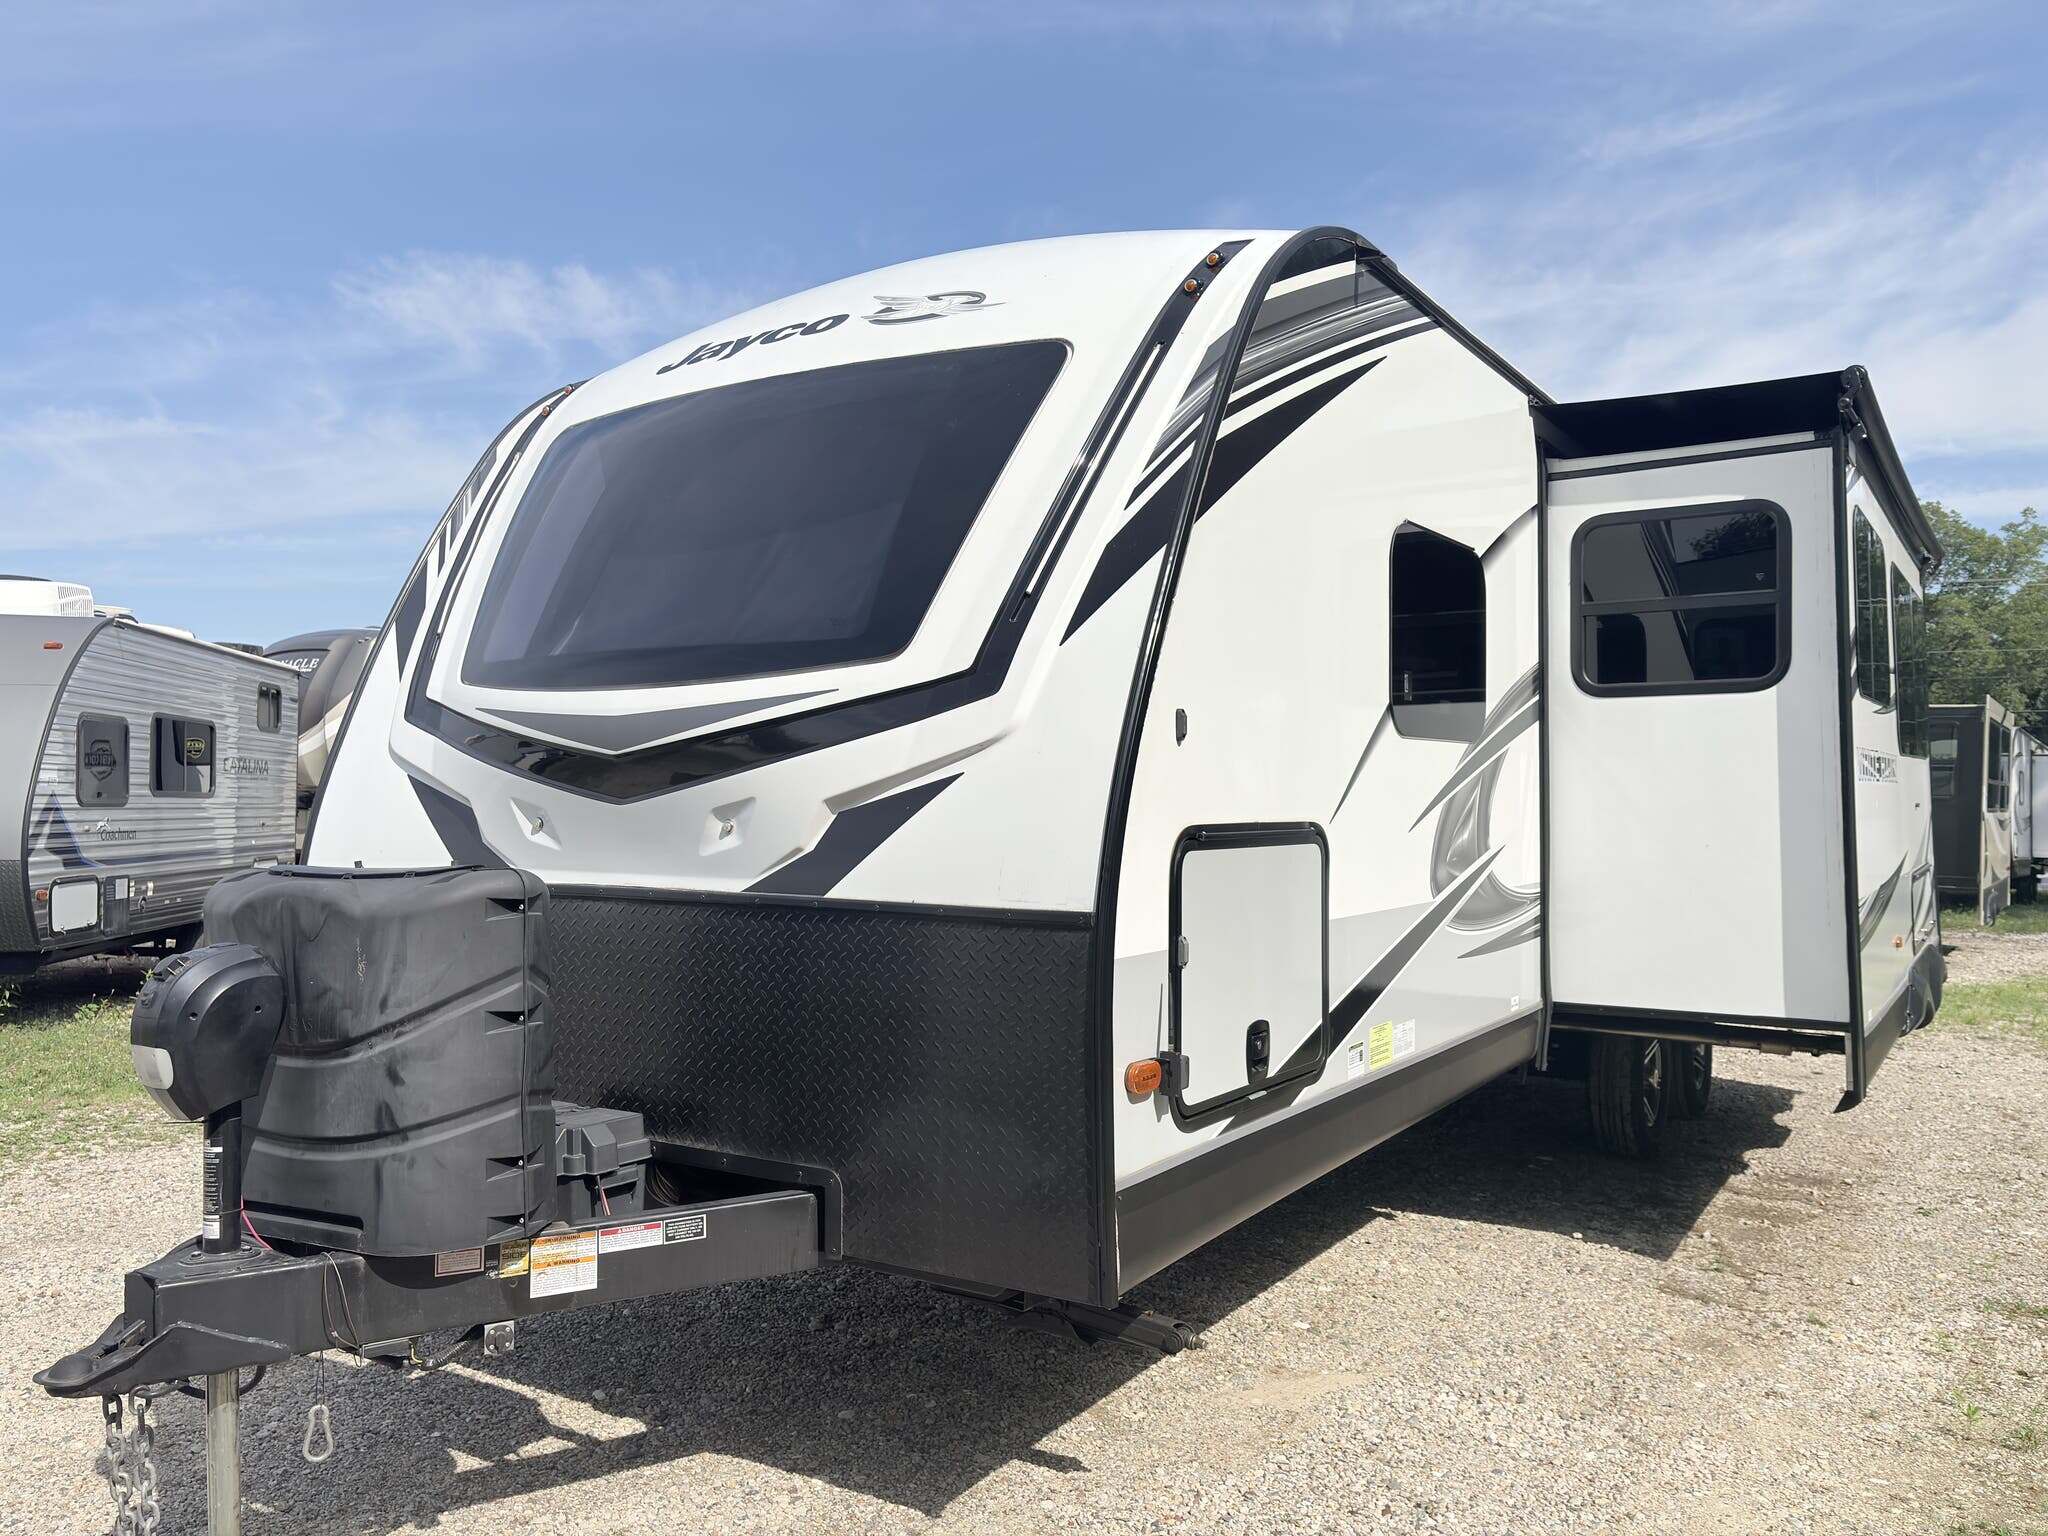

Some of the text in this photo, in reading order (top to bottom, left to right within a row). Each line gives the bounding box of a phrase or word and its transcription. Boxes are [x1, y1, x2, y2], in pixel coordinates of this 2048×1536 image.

[656, 313, 850, 375] Jayco
[223, 756, 269, 775] CATALINA
[623, 1225, 645, 1233] DANGER
[554, 1257, 581, 1265] WARNING
